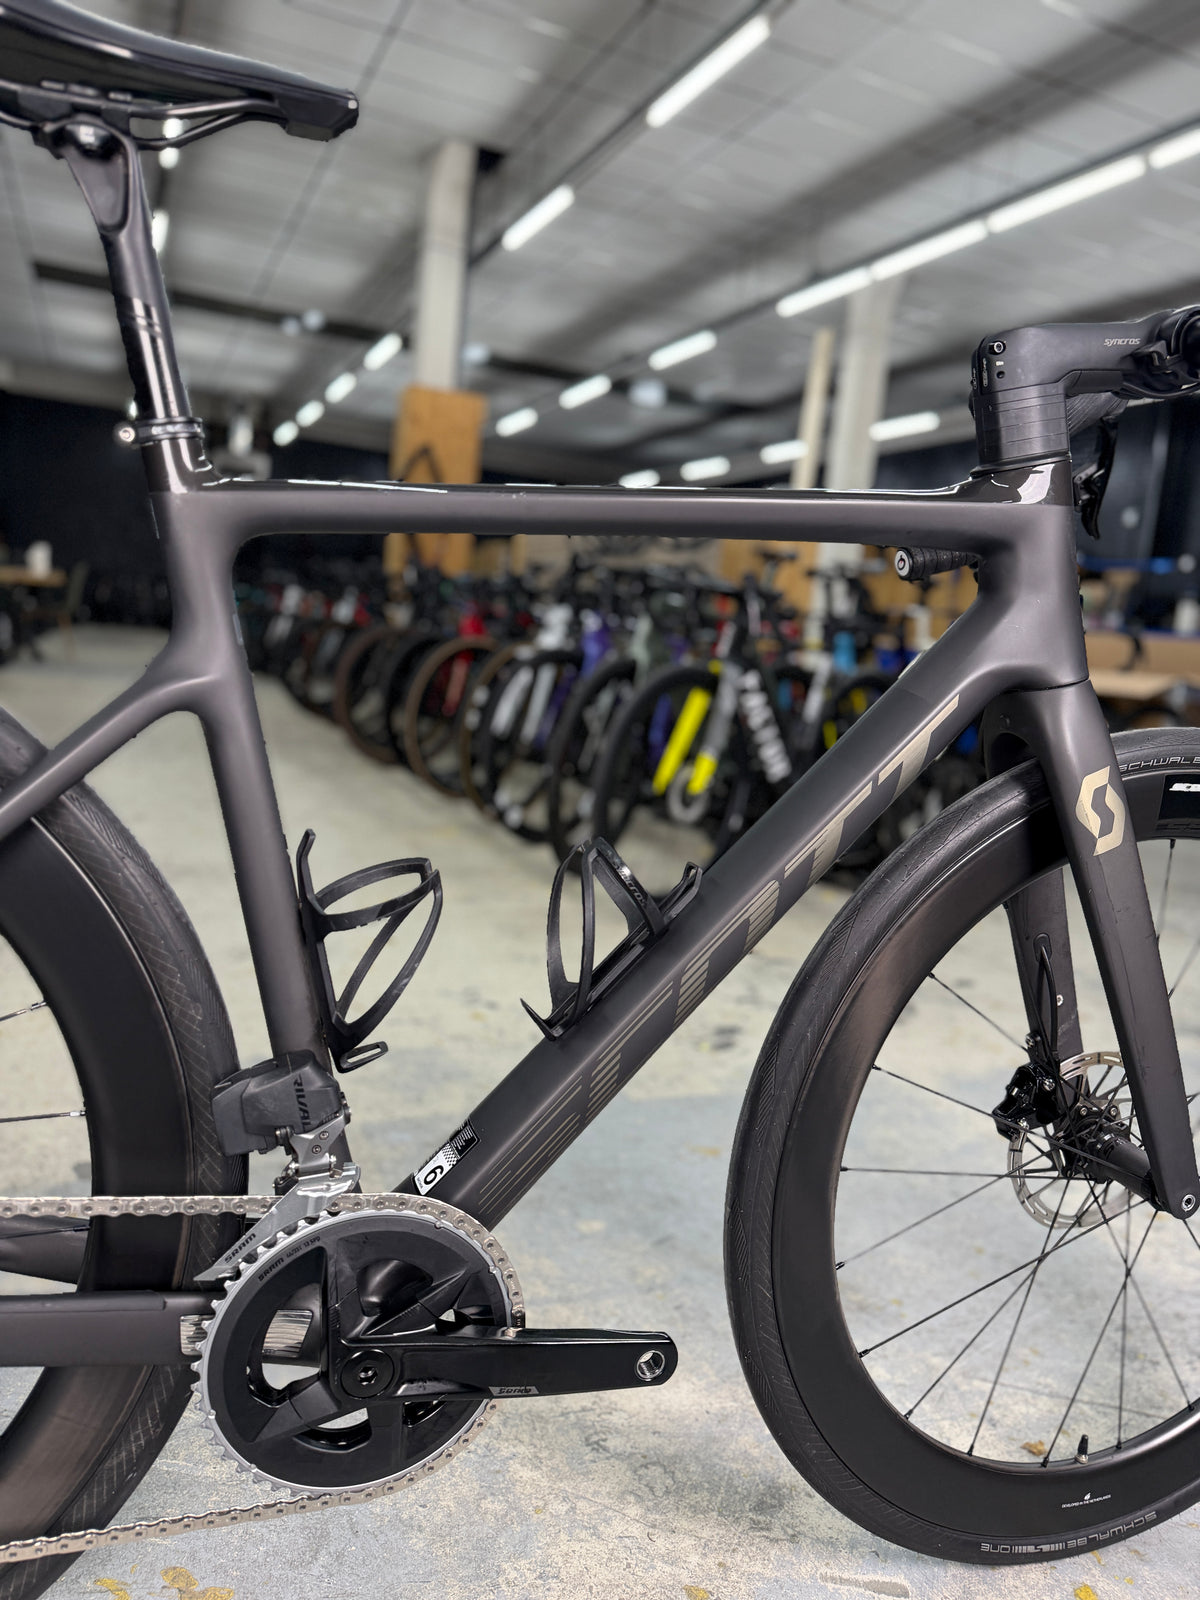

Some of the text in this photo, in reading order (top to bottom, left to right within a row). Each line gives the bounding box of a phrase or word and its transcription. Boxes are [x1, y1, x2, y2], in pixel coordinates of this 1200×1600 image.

[293, 1072, 312, 1132] RIVAL
[424, 1165, 444, 1185] 6
[224, 1233, 256, 1263] SRAM
[258, 1257, 285, 1282] SRAM
[980, 1511, 1157, 1554] SCHWALBE ONE
